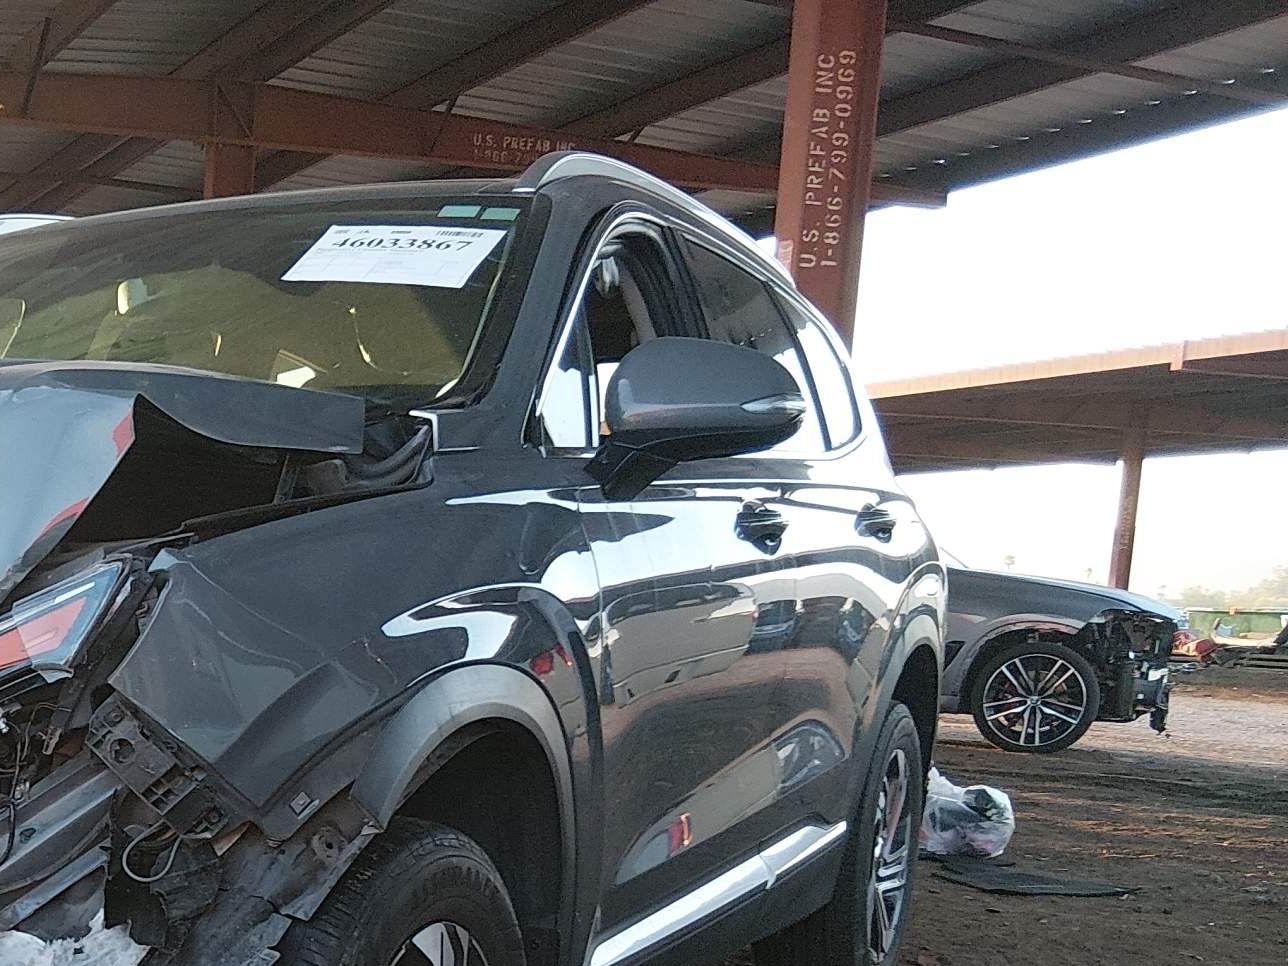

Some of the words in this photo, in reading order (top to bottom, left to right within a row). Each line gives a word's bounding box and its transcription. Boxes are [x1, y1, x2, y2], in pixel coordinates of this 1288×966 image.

[815, 54, 835, 93] INC
[503, 136, 550, 152] PREFAB
[804, 108, 831, 206] PREFAB
[820, 50, 857, 267] 1-866-799-0969
[331, 237, 473, 252] 46033867
[799, 222, 822, 268] U.S.
